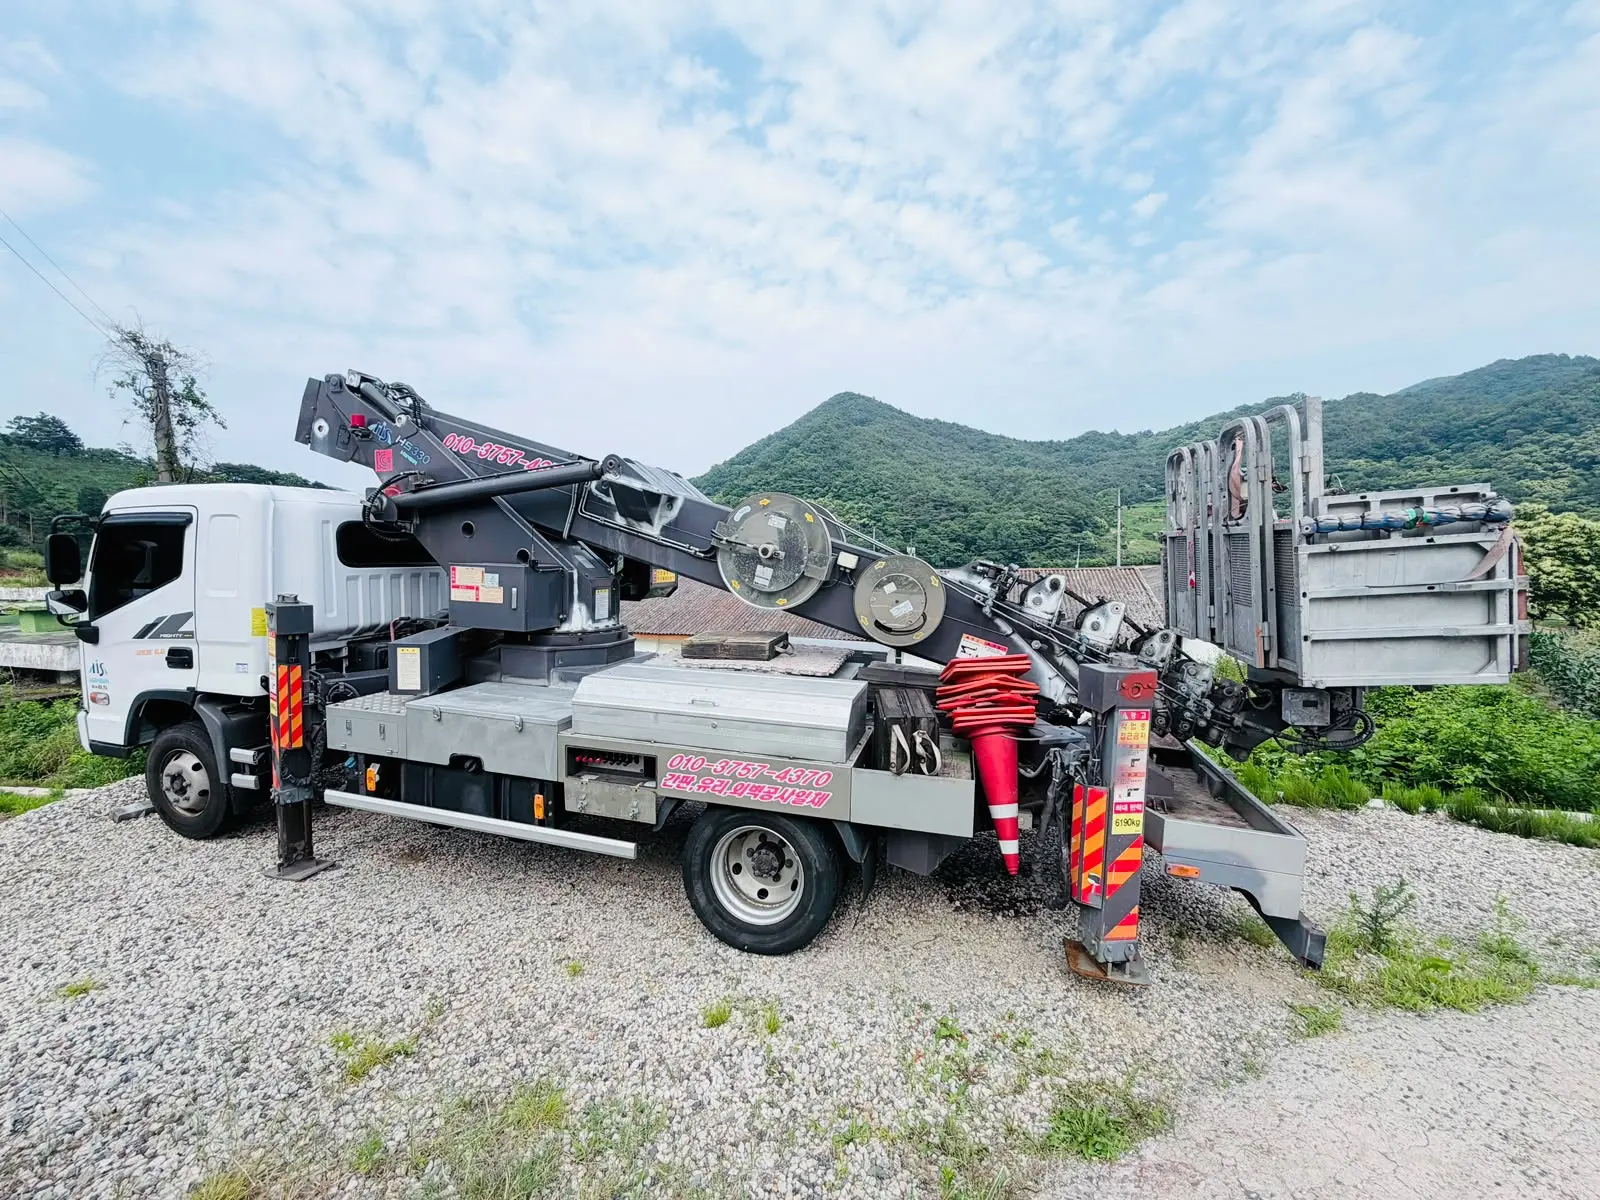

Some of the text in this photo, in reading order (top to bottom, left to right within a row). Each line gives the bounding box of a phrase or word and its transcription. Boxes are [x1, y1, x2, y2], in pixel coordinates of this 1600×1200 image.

[443, 433, 553, 470] 010-3757-4
[667, 754, 833, 787] 010-3757-4370
[1115, 818, 1141, 828] 6190kg
